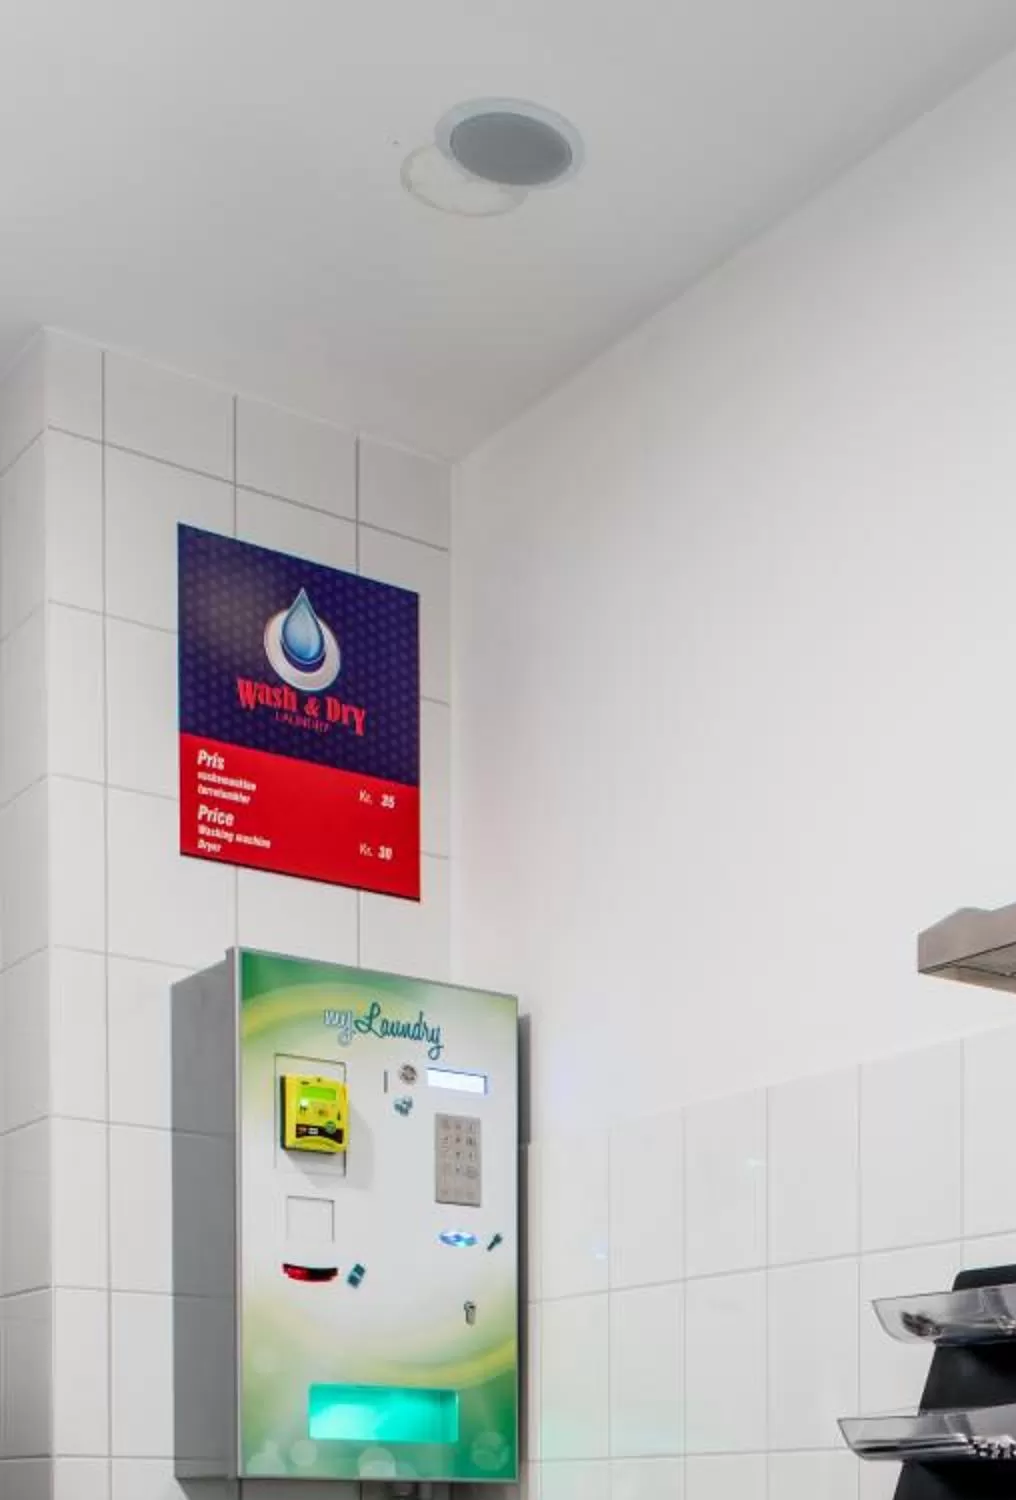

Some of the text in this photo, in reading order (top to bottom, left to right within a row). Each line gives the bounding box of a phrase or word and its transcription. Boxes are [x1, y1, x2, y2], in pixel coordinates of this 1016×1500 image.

[237, 677, 365, 736] Wash & Dry
[198, 749, 224, 770] Pris
[198, 804, 234, 826] Price
[235, 833, 271, 849] machine
